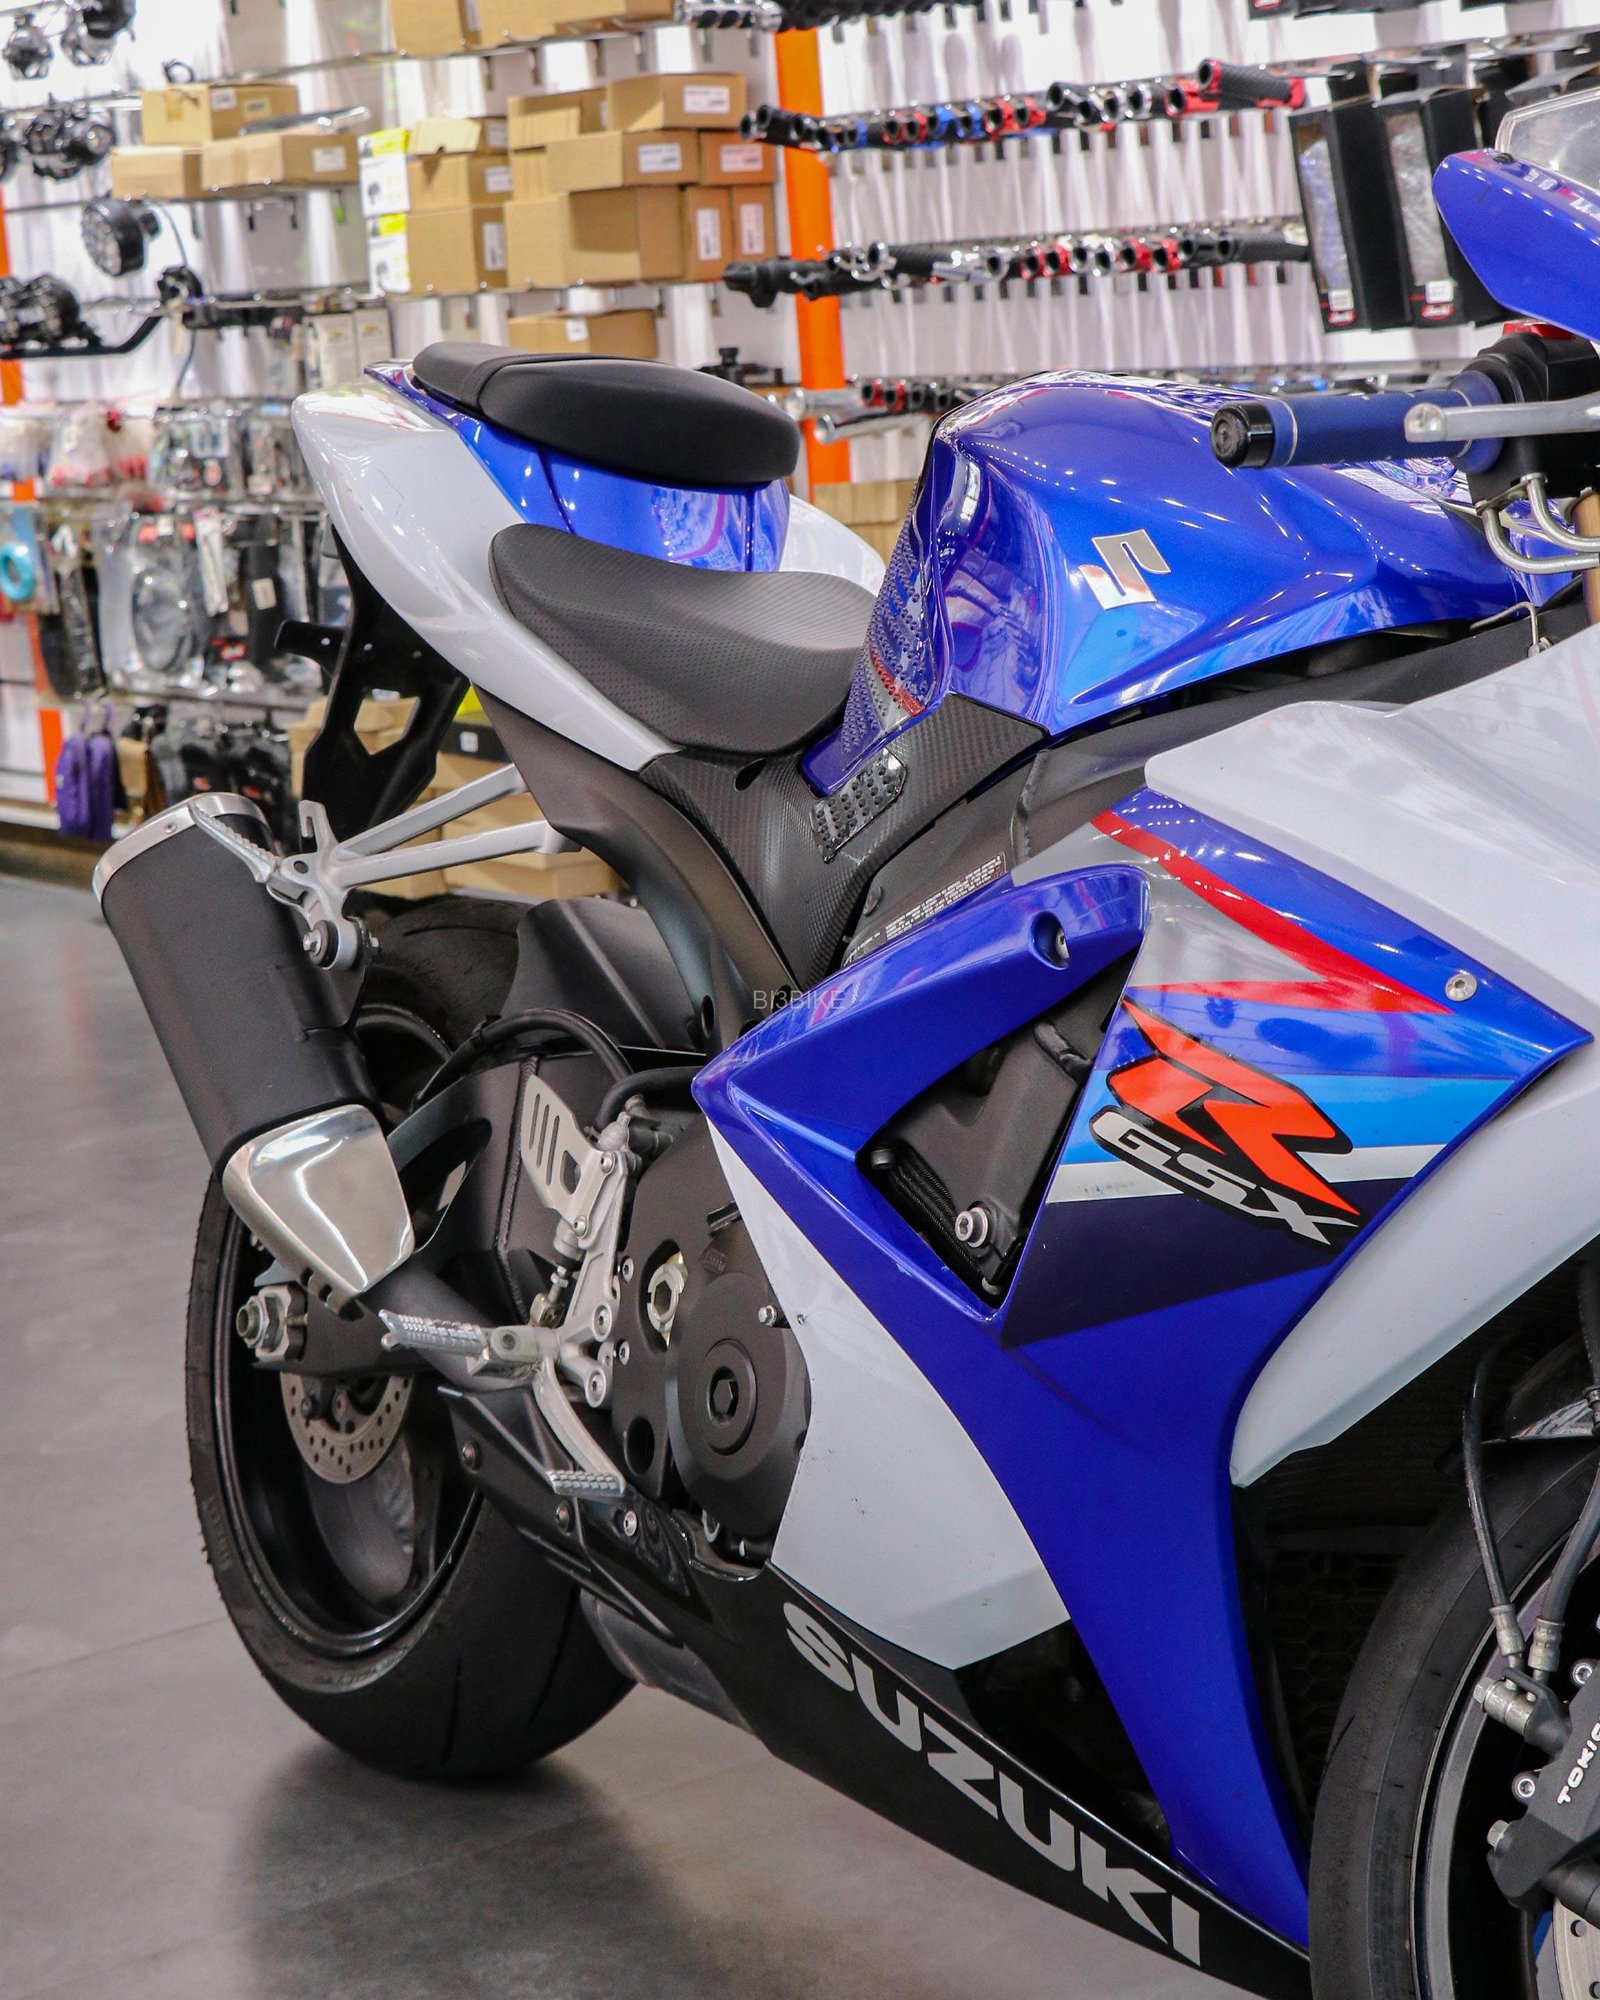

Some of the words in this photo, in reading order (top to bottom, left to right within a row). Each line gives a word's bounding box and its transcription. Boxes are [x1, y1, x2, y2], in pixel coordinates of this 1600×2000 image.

[1091, 1110, 1360, 1246] GSX
[1110, 999, 1360, 1216] R
[783, 1602, 1201, 1967] SUZUKI
[1556, 1714, 1600, 1804] TOKIC
